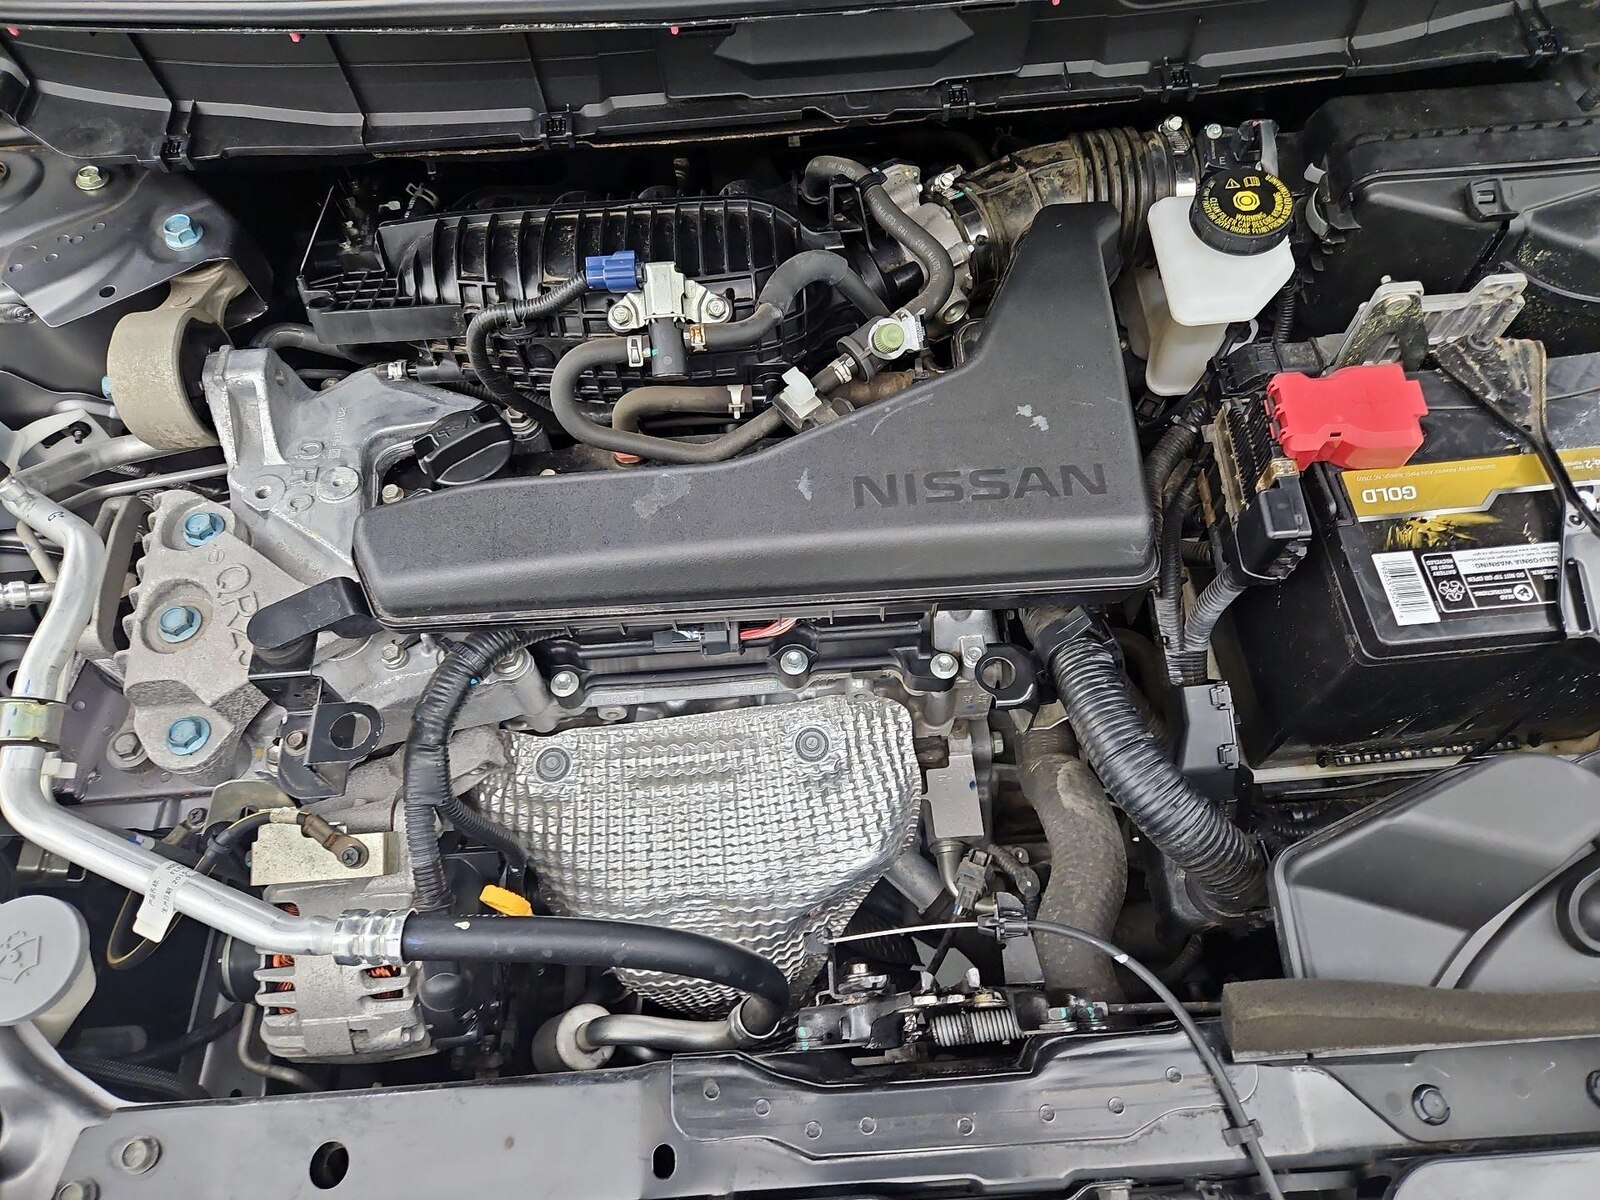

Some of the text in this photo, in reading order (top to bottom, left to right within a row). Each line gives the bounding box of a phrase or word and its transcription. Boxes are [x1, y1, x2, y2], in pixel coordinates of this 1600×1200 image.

[1210, 197, 1223, 214] CLEAN
[1217, 211, 1238, 227] FILLER
[1237, 218, 1251, 228] CAP
[1251, 215, 1277, 228] BEFORE
[1235, 211, 1267, 222] WARNING
[1230, 225, 1251, 235] BRAKE
[852, 463, 1108, 509] NISSAN
[1362, 485, 1417, 503] GOLD
[1503, 572, 1516, 580] NOT
